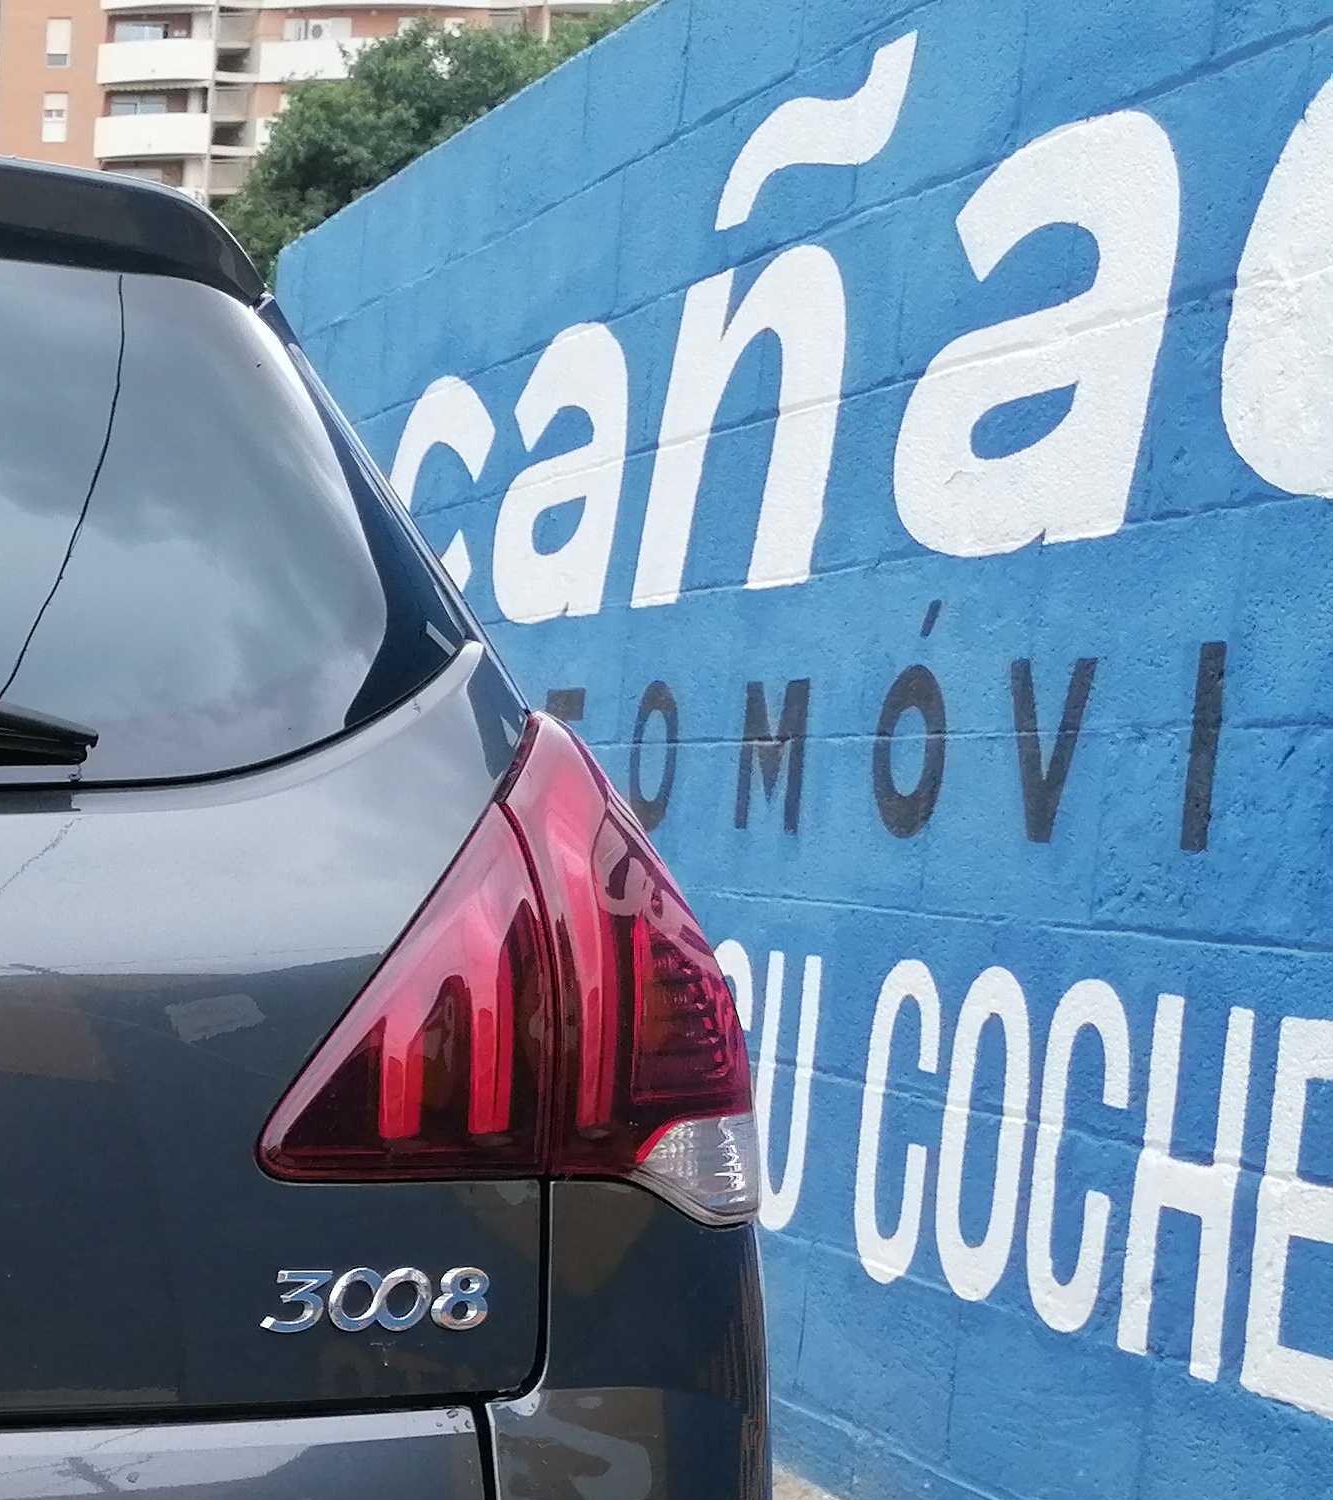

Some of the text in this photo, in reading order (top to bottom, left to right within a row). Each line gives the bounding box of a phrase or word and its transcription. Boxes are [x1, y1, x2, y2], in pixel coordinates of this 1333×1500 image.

[259, 1266, 490, 1333] 3008
[714, 939, 1333, 1420] U COCHE
